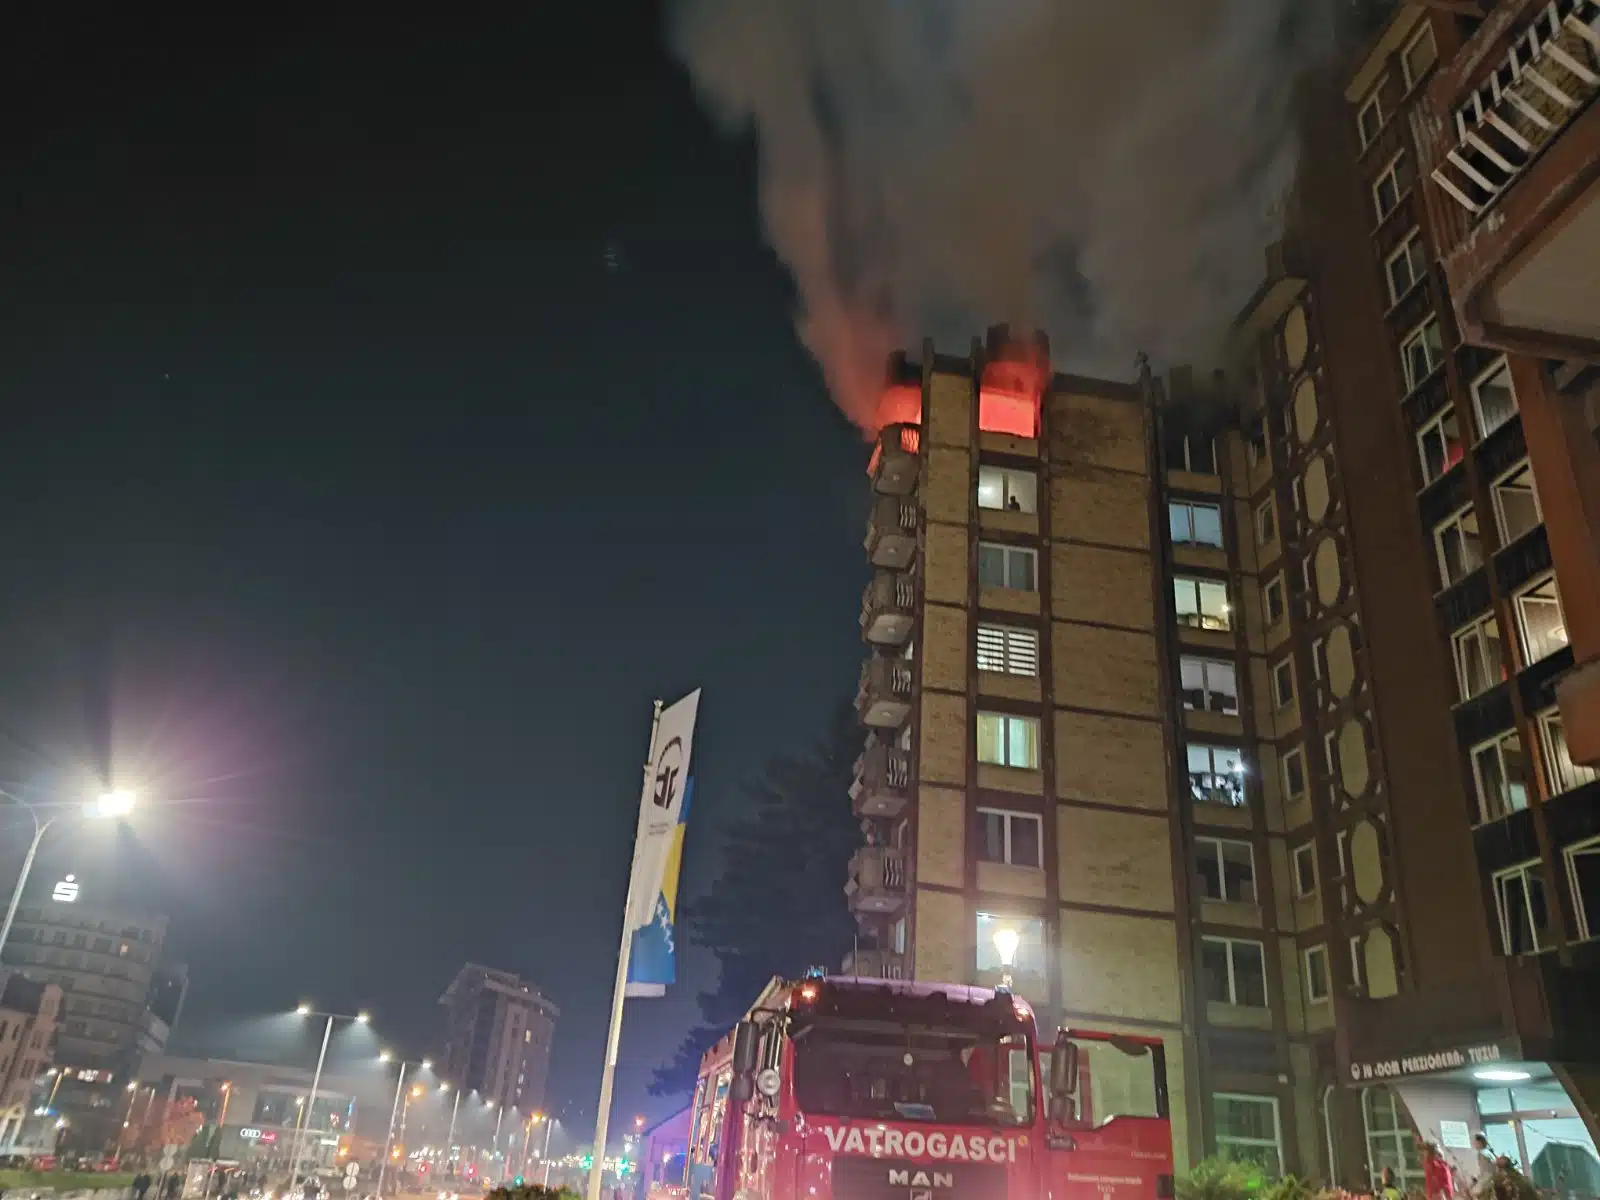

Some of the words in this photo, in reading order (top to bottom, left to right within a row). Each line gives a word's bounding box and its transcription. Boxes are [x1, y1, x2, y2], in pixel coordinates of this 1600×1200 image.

[1468, 1043, 1500, 1063] TUZLA
[825, 1126, 1016, 1163] VATROGASCI
[889, 1169, 953, 1187] MAN
